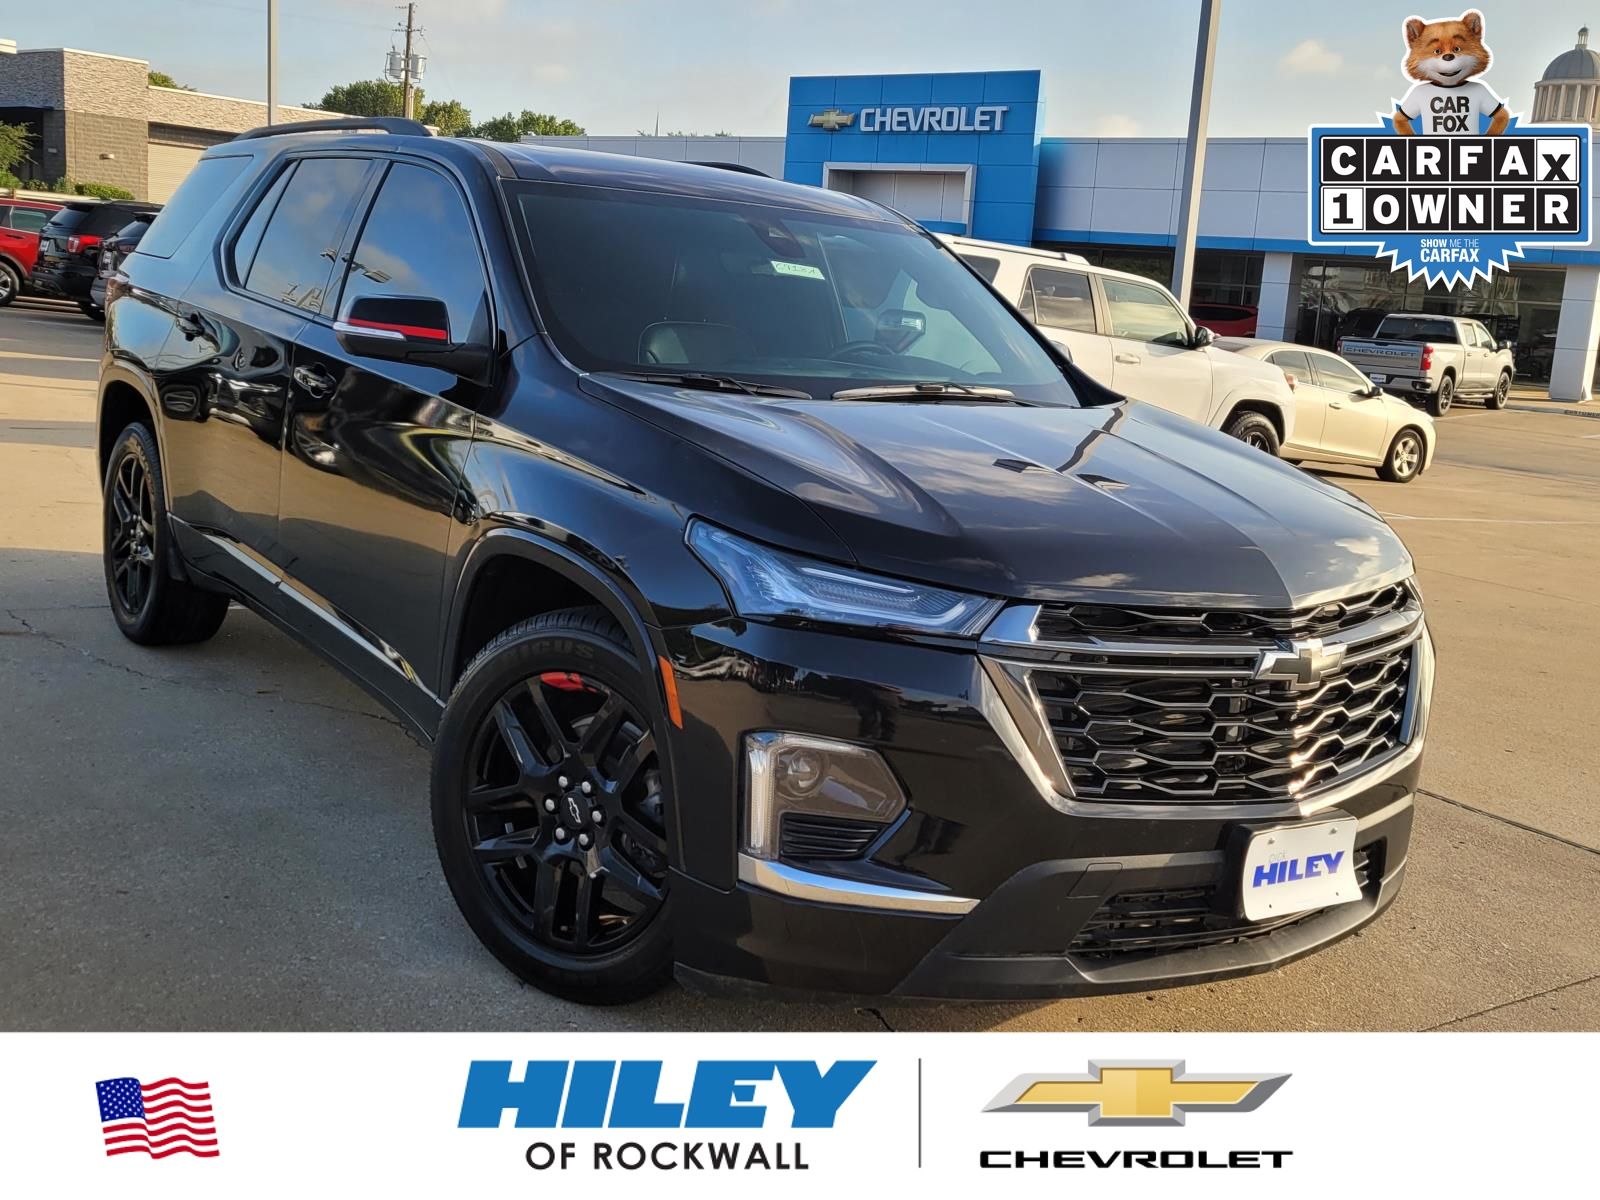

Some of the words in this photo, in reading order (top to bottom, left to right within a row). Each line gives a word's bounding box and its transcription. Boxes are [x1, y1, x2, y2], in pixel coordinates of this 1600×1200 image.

[860, 106, 1009, 132] CHEVROLET
[1345, 346, 1417, 358] CHEVROLET
[1252, 850, 1345, 888] HILEY
